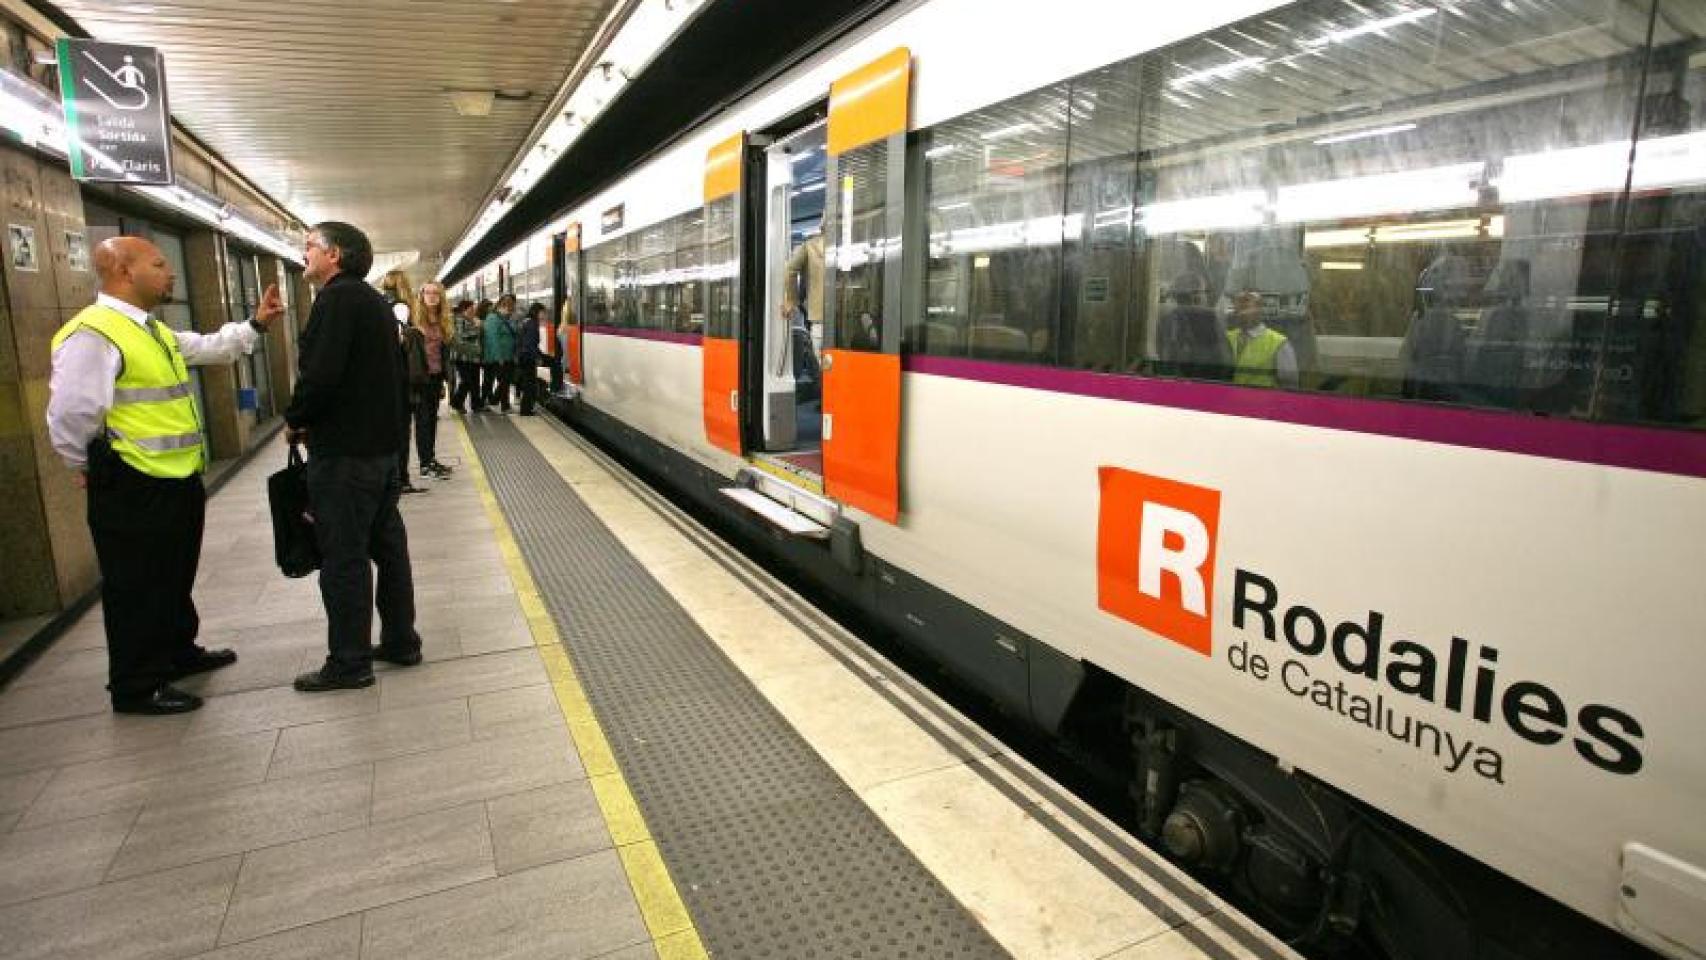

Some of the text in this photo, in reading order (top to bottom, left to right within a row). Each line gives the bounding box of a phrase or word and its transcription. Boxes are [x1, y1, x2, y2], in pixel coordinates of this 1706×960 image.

[1139, 501, 1210, 617] R
[1228, 641, 1506, 785] de Catalunya
[1232, 568, 1645, 776] Rodalies
